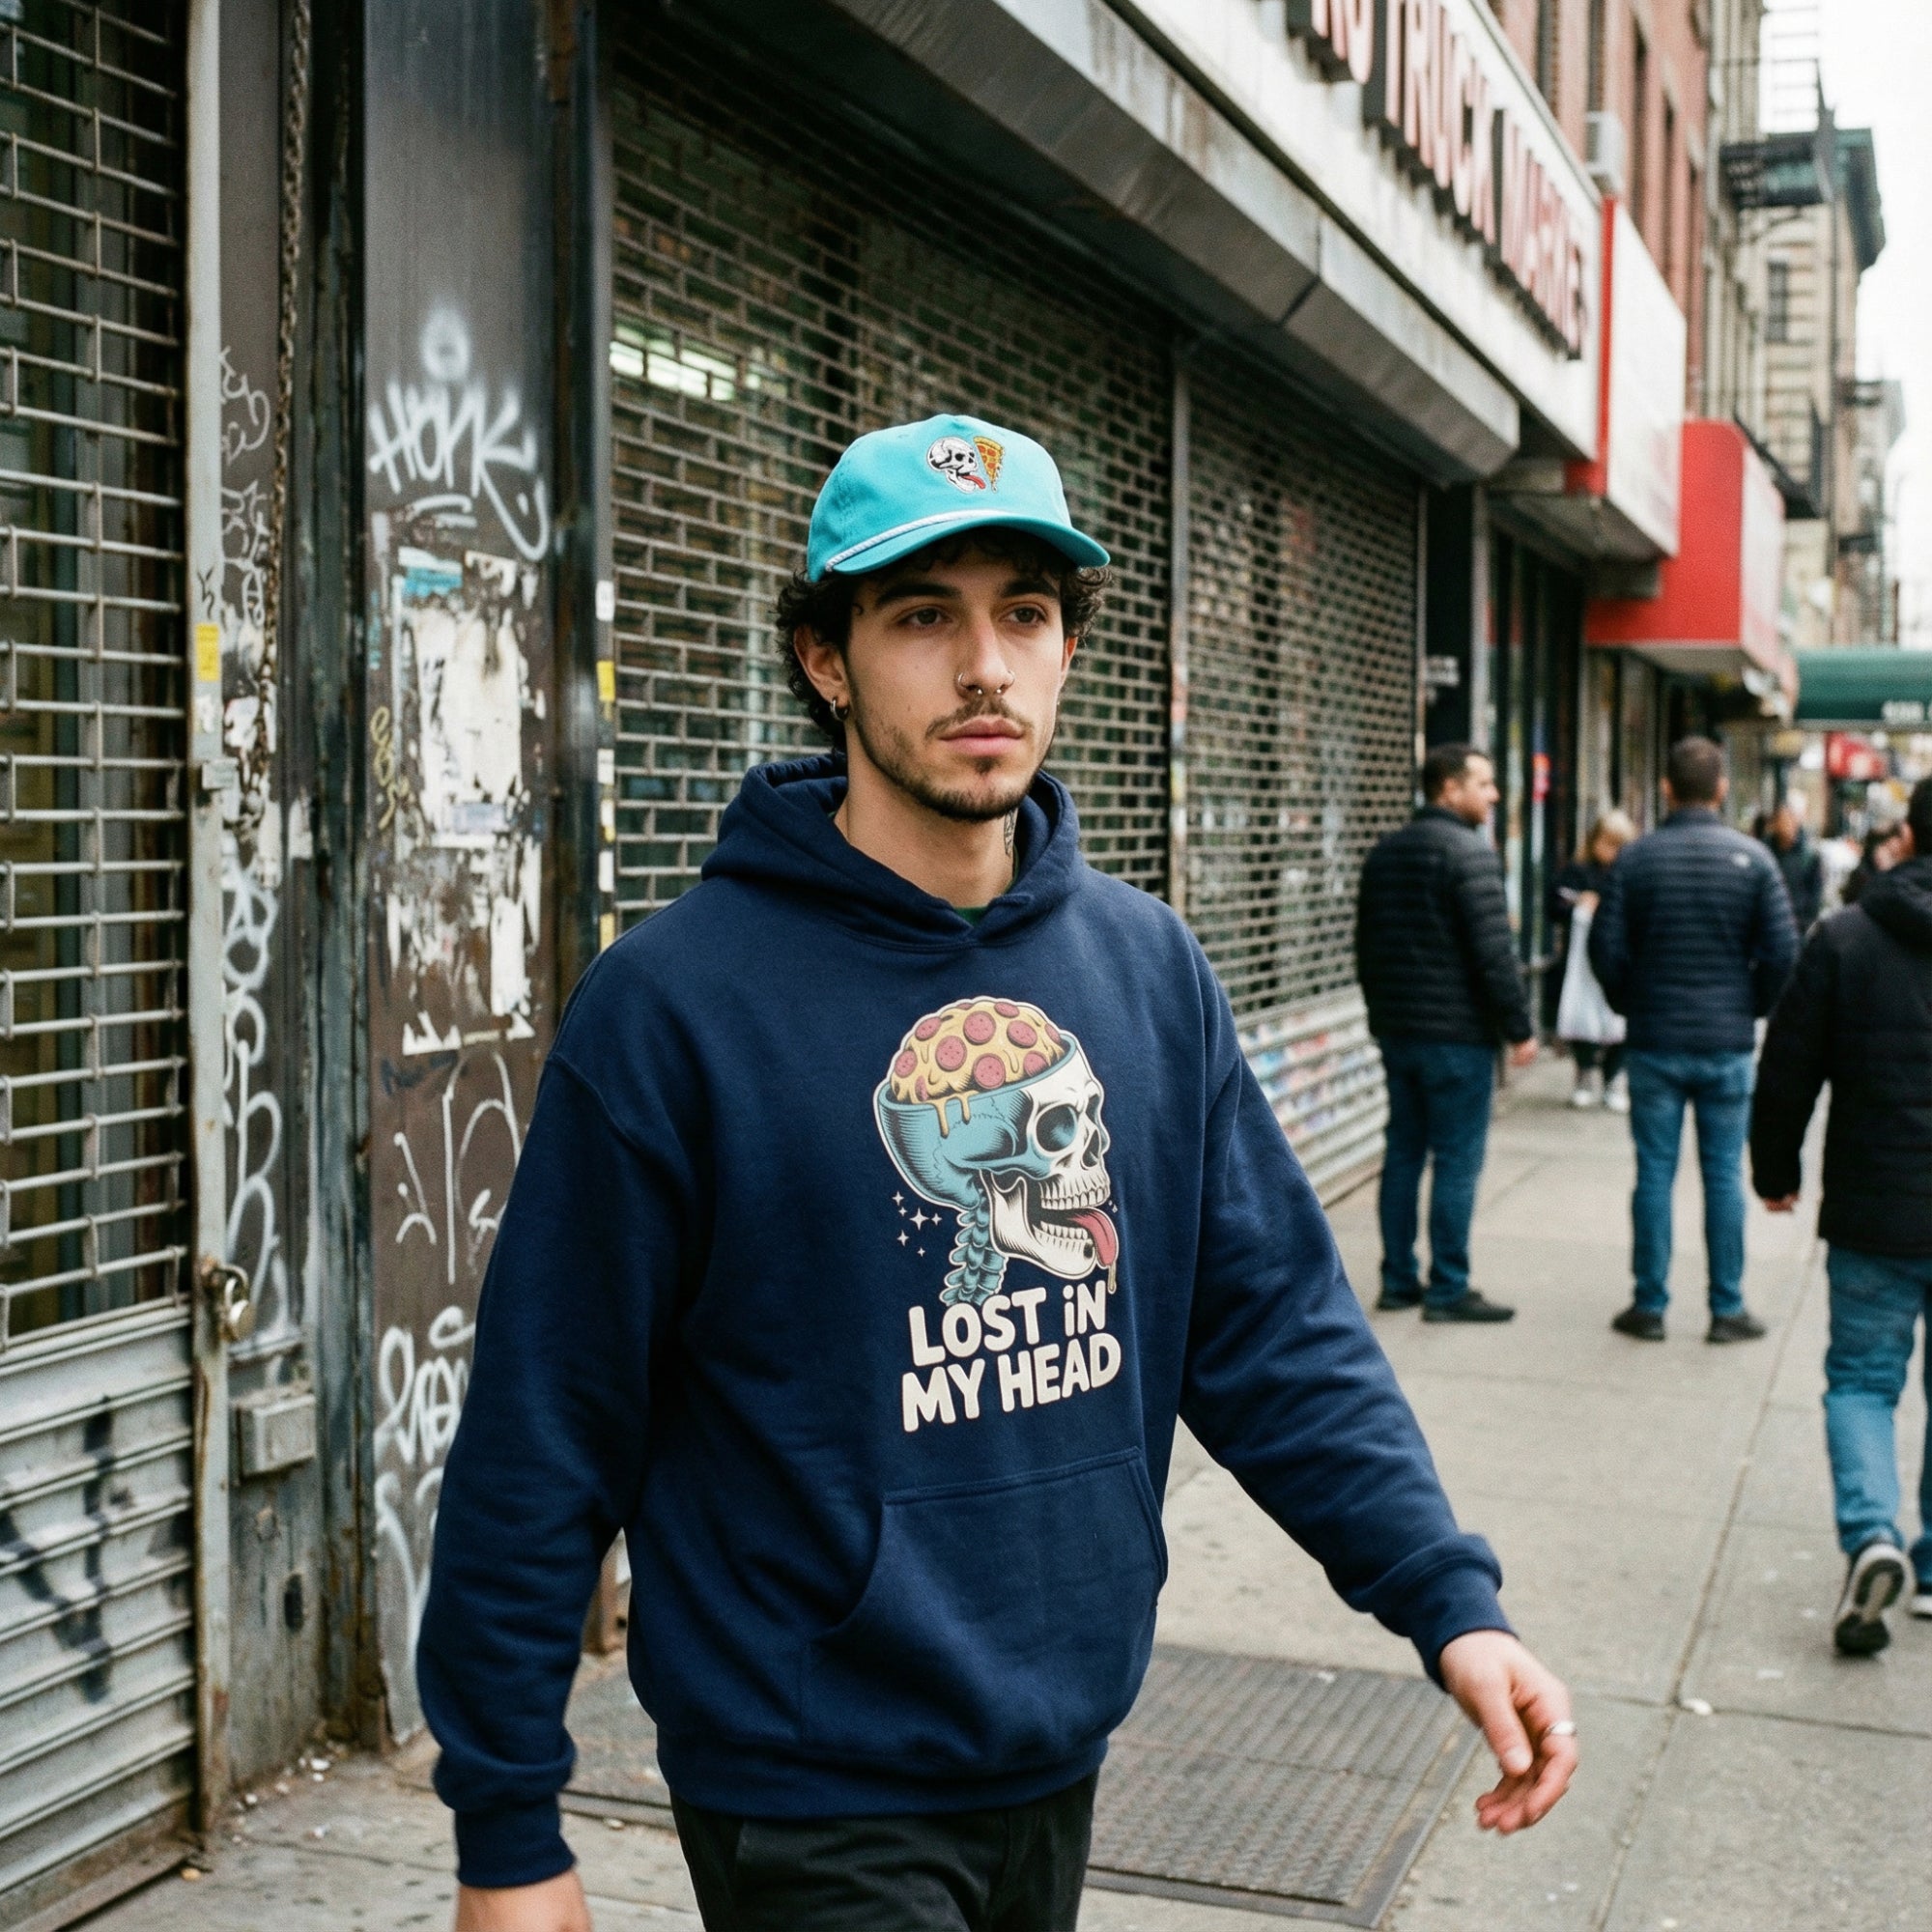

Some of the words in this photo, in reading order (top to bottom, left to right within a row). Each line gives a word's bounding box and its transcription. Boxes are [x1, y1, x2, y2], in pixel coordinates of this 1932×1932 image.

[908, 1287, 1046, 1366] LOST
[901, 1358, 986, 1433] MY
[997, 1332, 1122, 1413] HEAD
